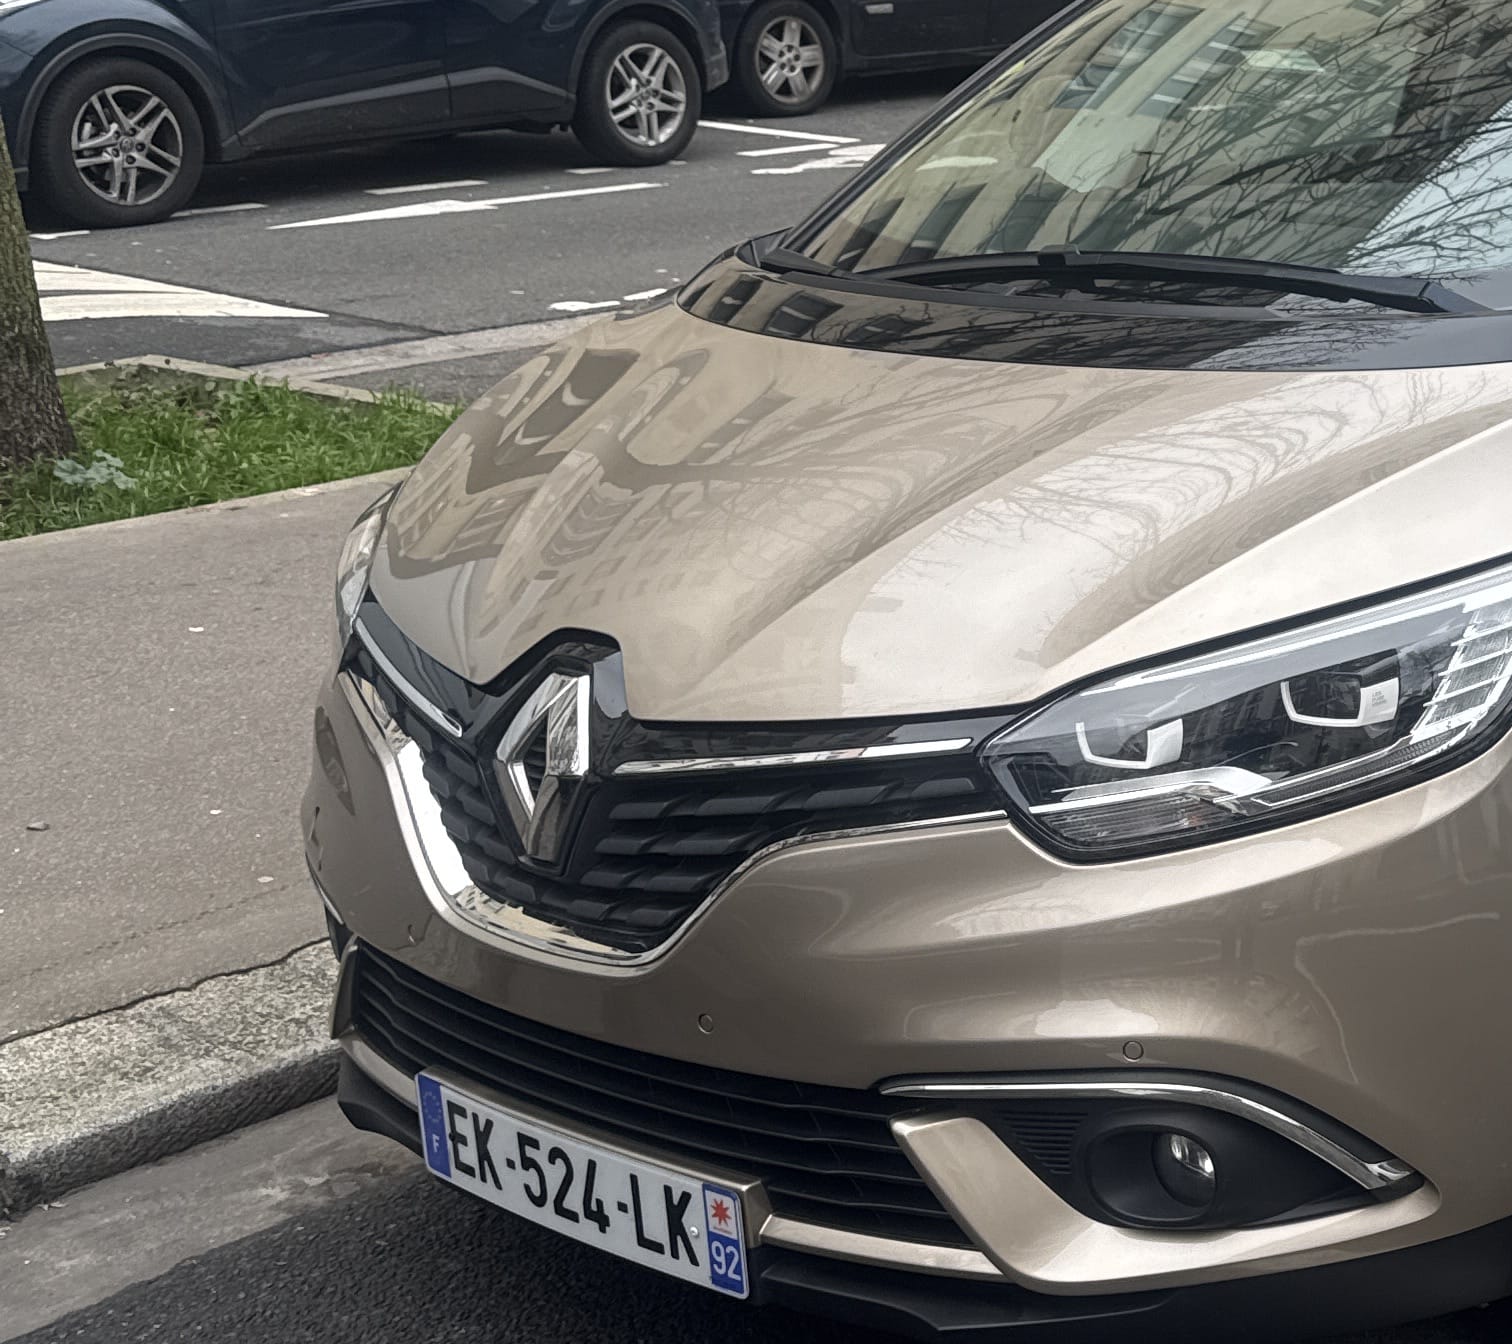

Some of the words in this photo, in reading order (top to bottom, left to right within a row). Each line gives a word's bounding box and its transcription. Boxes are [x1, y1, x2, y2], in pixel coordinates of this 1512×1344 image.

[432, 1134, 441, 1154] F
[446, 1099, 699, 1267] EK-524-LK
[710, 1241, 742, 1282] 92
